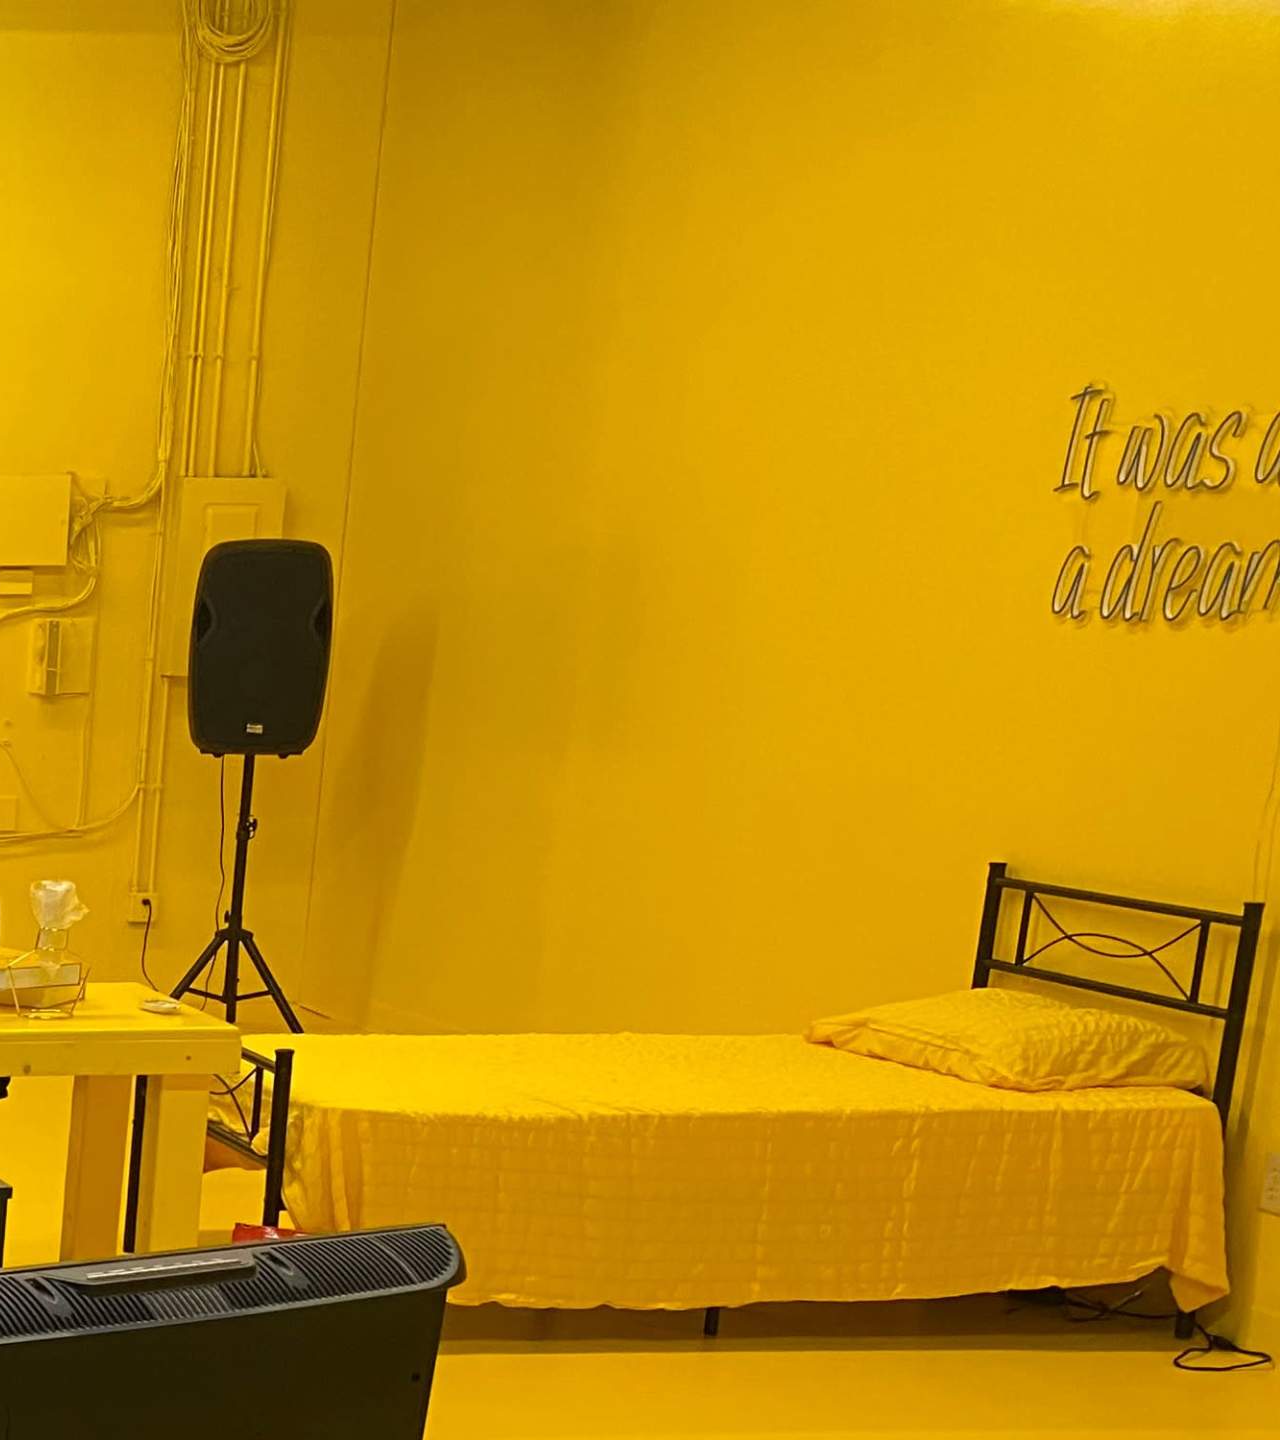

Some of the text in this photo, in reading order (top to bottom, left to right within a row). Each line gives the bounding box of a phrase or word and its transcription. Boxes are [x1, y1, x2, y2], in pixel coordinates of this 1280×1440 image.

[1053, 384, 1112, 500] It
[1116, 410, 1246, 492] was
[1051, 544, 1092, 620] a
